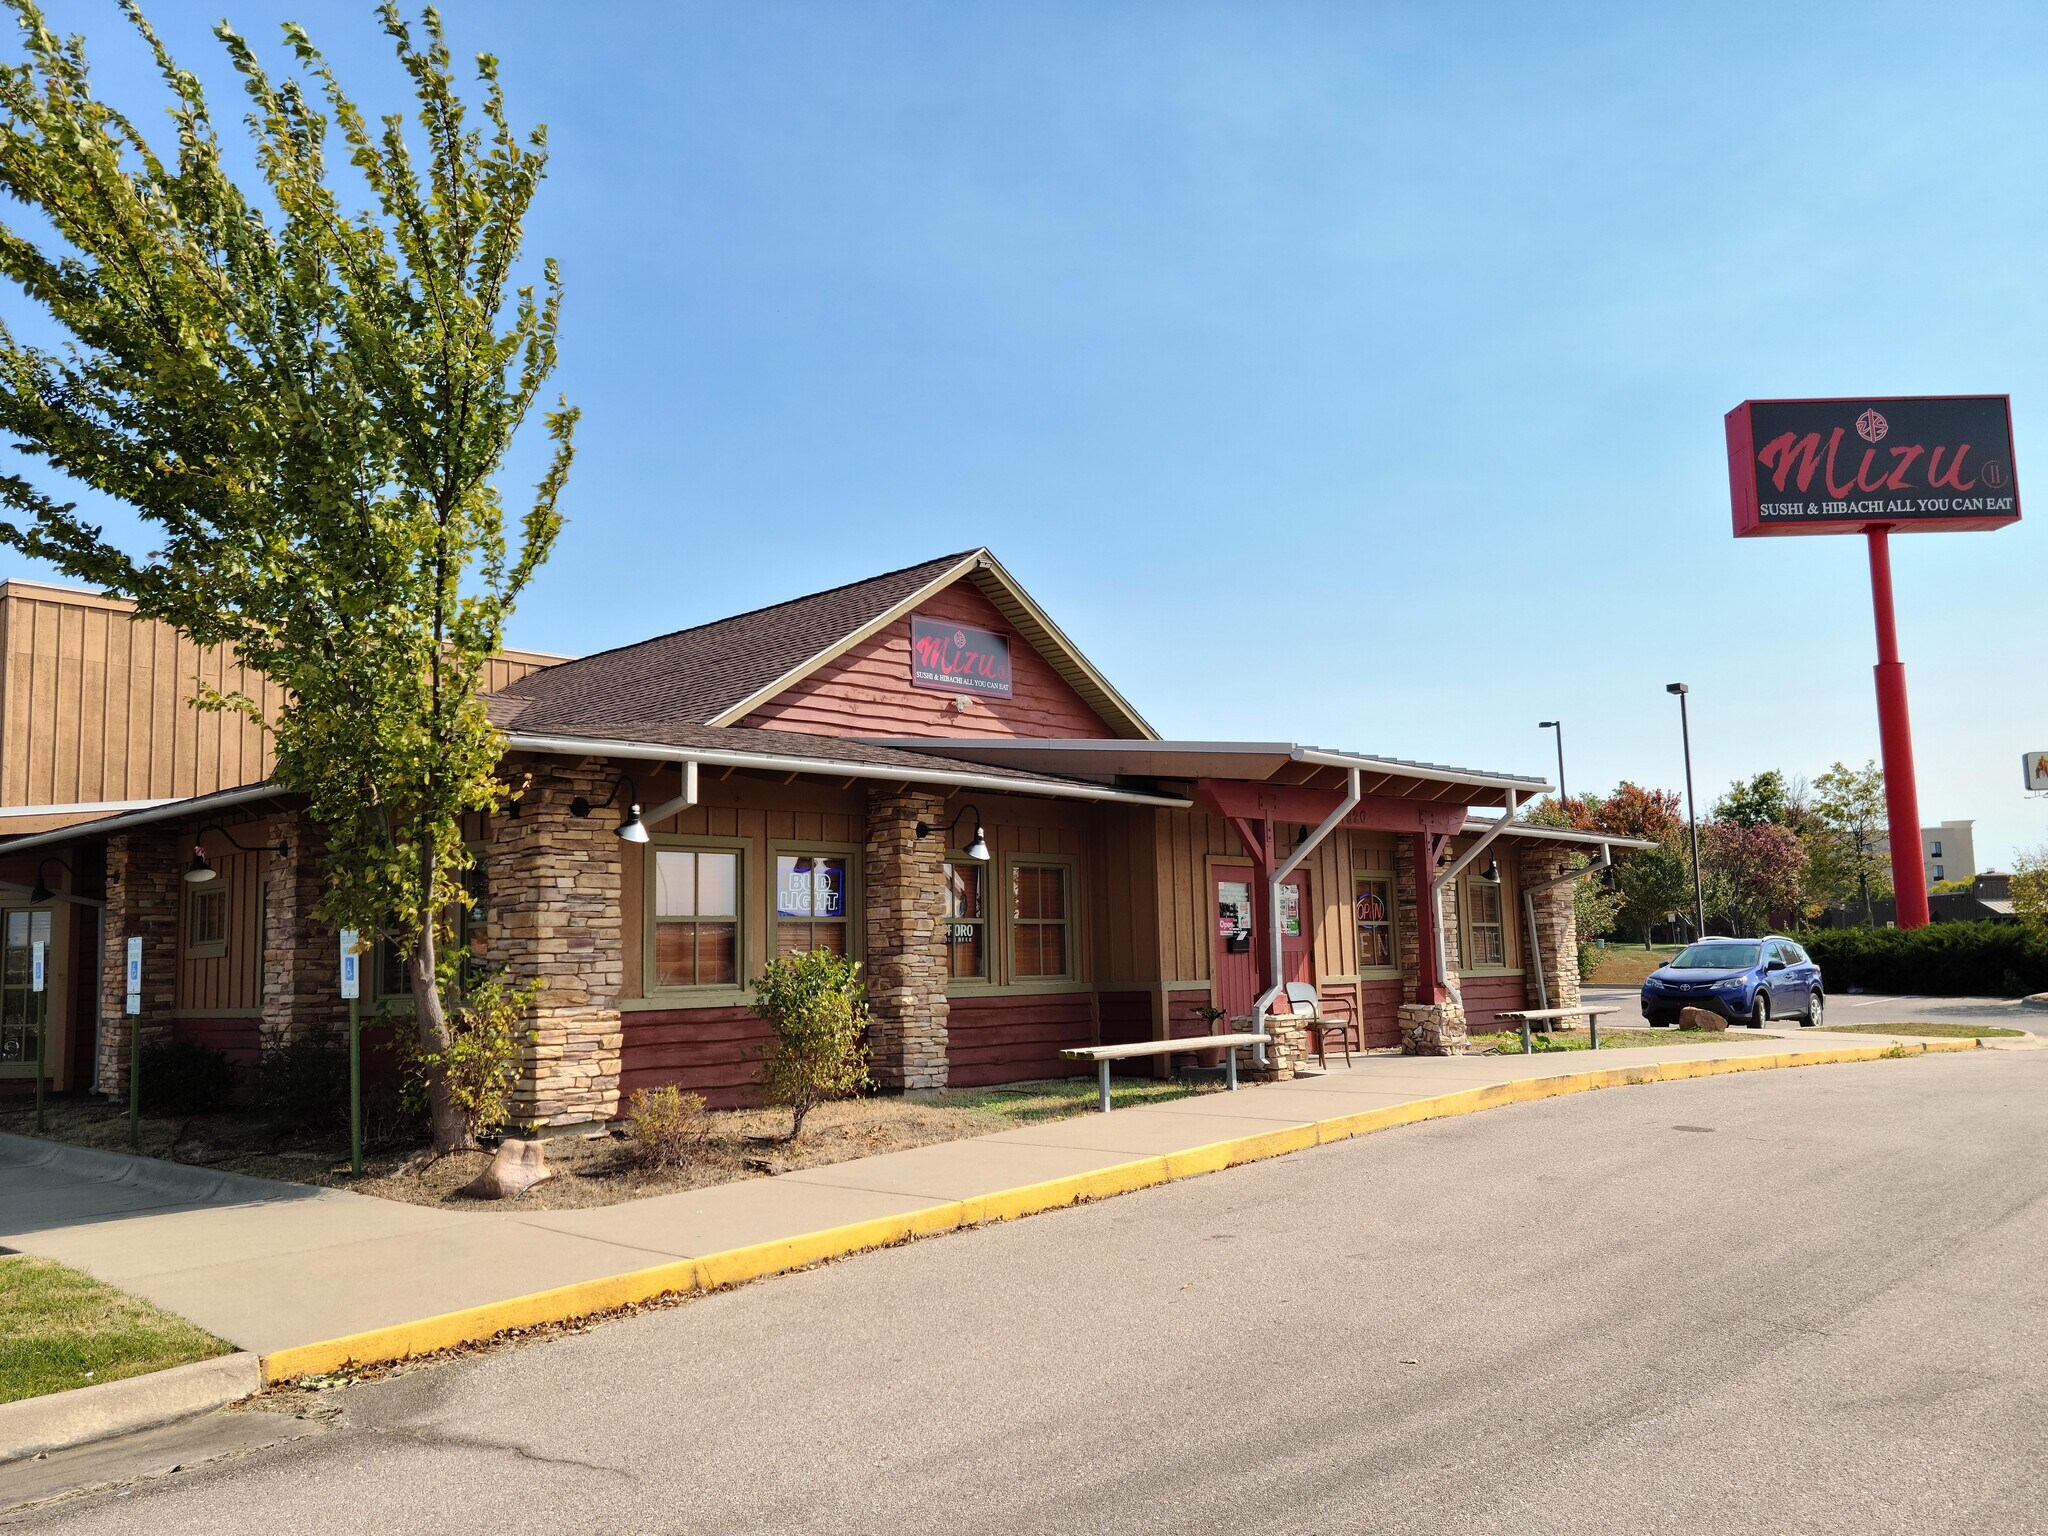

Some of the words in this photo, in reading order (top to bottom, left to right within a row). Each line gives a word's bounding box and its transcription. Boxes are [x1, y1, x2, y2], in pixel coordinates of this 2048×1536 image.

[1758, 426, 1976, 499] Mizu
[1760, 503, 1804, 516] SUSHI
[1807, 502, 1819, 514] &
[1822, 500, 1884, 514] HIBACHI
[1886, 499, 1915, 512] ALL
[1917, 499, 1949, 511] YOU
[1952, 498, 1983, 510] CAN
[1986, 497, 2012, 510] EAT
[916, 636, 996, 679] Mizu
[916, 671, 934, 680] SUSHI
[940, 674, 963, 684] HIBACHI
[974, 680, 987, 688] YOU
[987, 681, 999, 689] CAN
[789, 873, 831, 891] BUD
[780, 891, 838, 910] LIGHT
